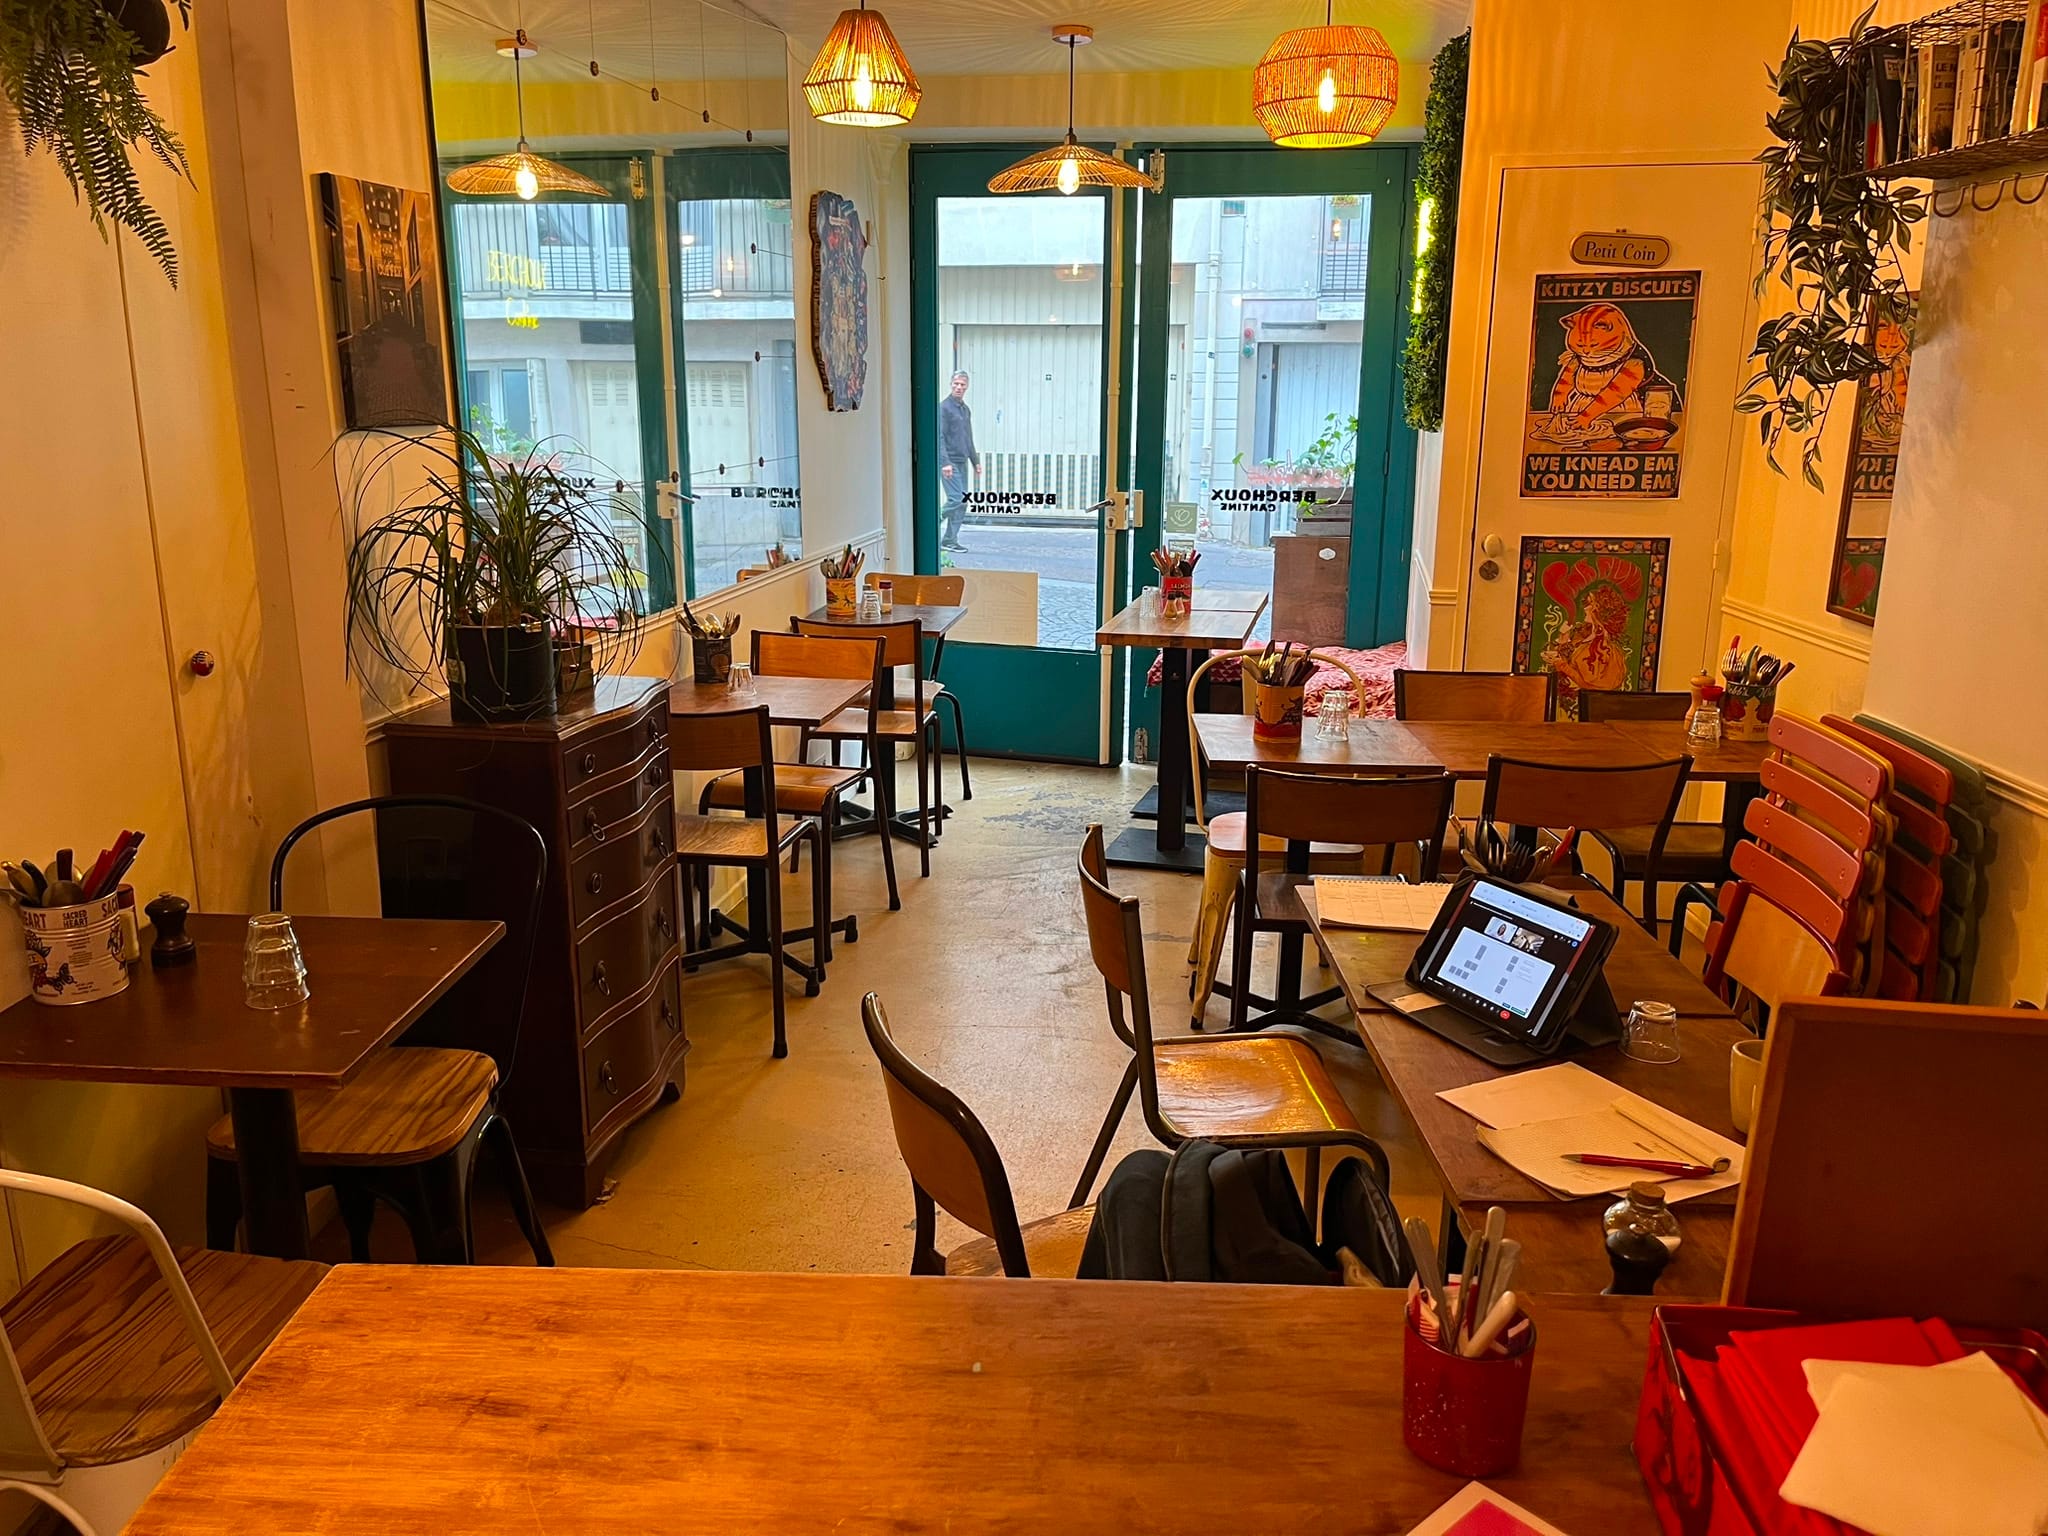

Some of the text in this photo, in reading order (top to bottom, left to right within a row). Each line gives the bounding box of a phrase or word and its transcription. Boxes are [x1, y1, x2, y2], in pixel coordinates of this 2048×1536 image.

[1584, 241, 1657, 261] Petit Coin
[1541, 278, 1693, 298] KITTZY BISCUITS
[1529, 456, 1675, 472] WE KNEAD EM
[1527, 473, 1672, 490] YOU NEED EM
[62, 909, 88, 920] SACRED
[63, 918, 88, 929] HEART
